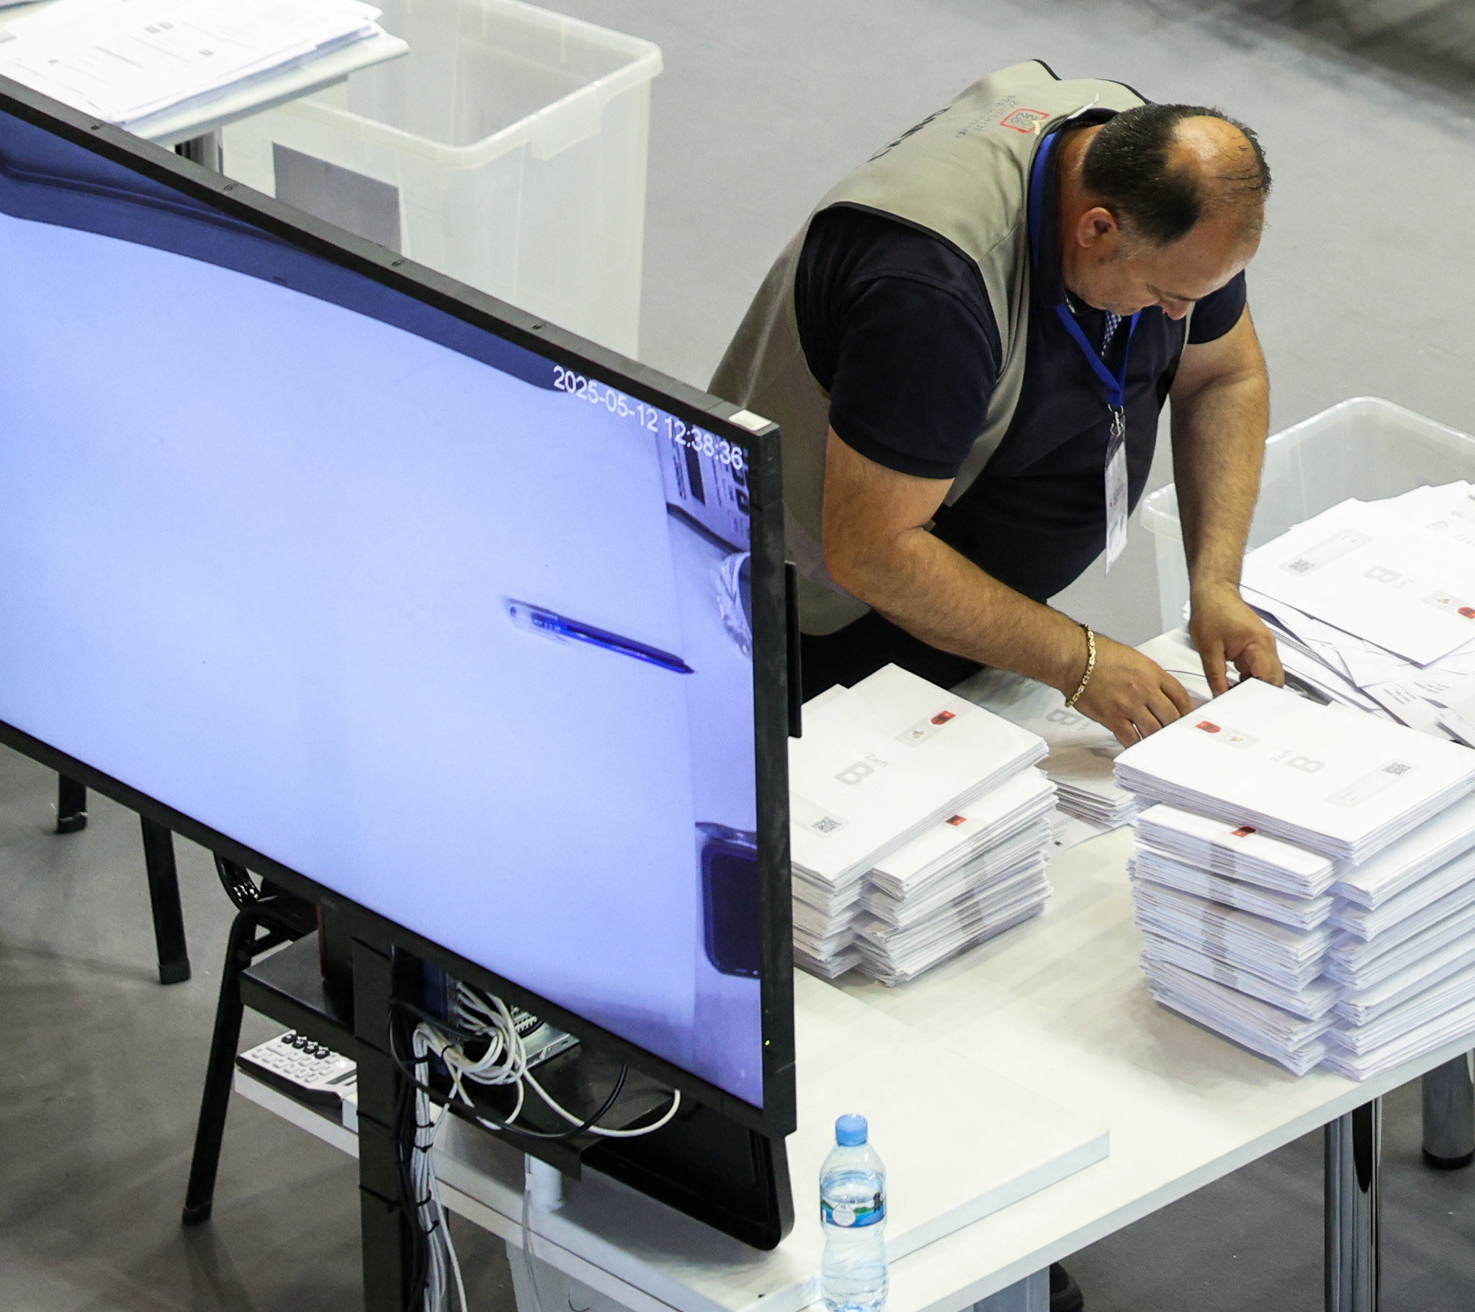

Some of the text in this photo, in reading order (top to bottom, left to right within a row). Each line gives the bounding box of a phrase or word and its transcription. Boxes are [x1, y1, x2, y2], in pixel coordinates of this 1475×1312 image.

[553, 365, 745, 471] 2025-05-12 12:38:36
[834, 759, 875, 786] B
[1285, 756, 1327, 774] B
